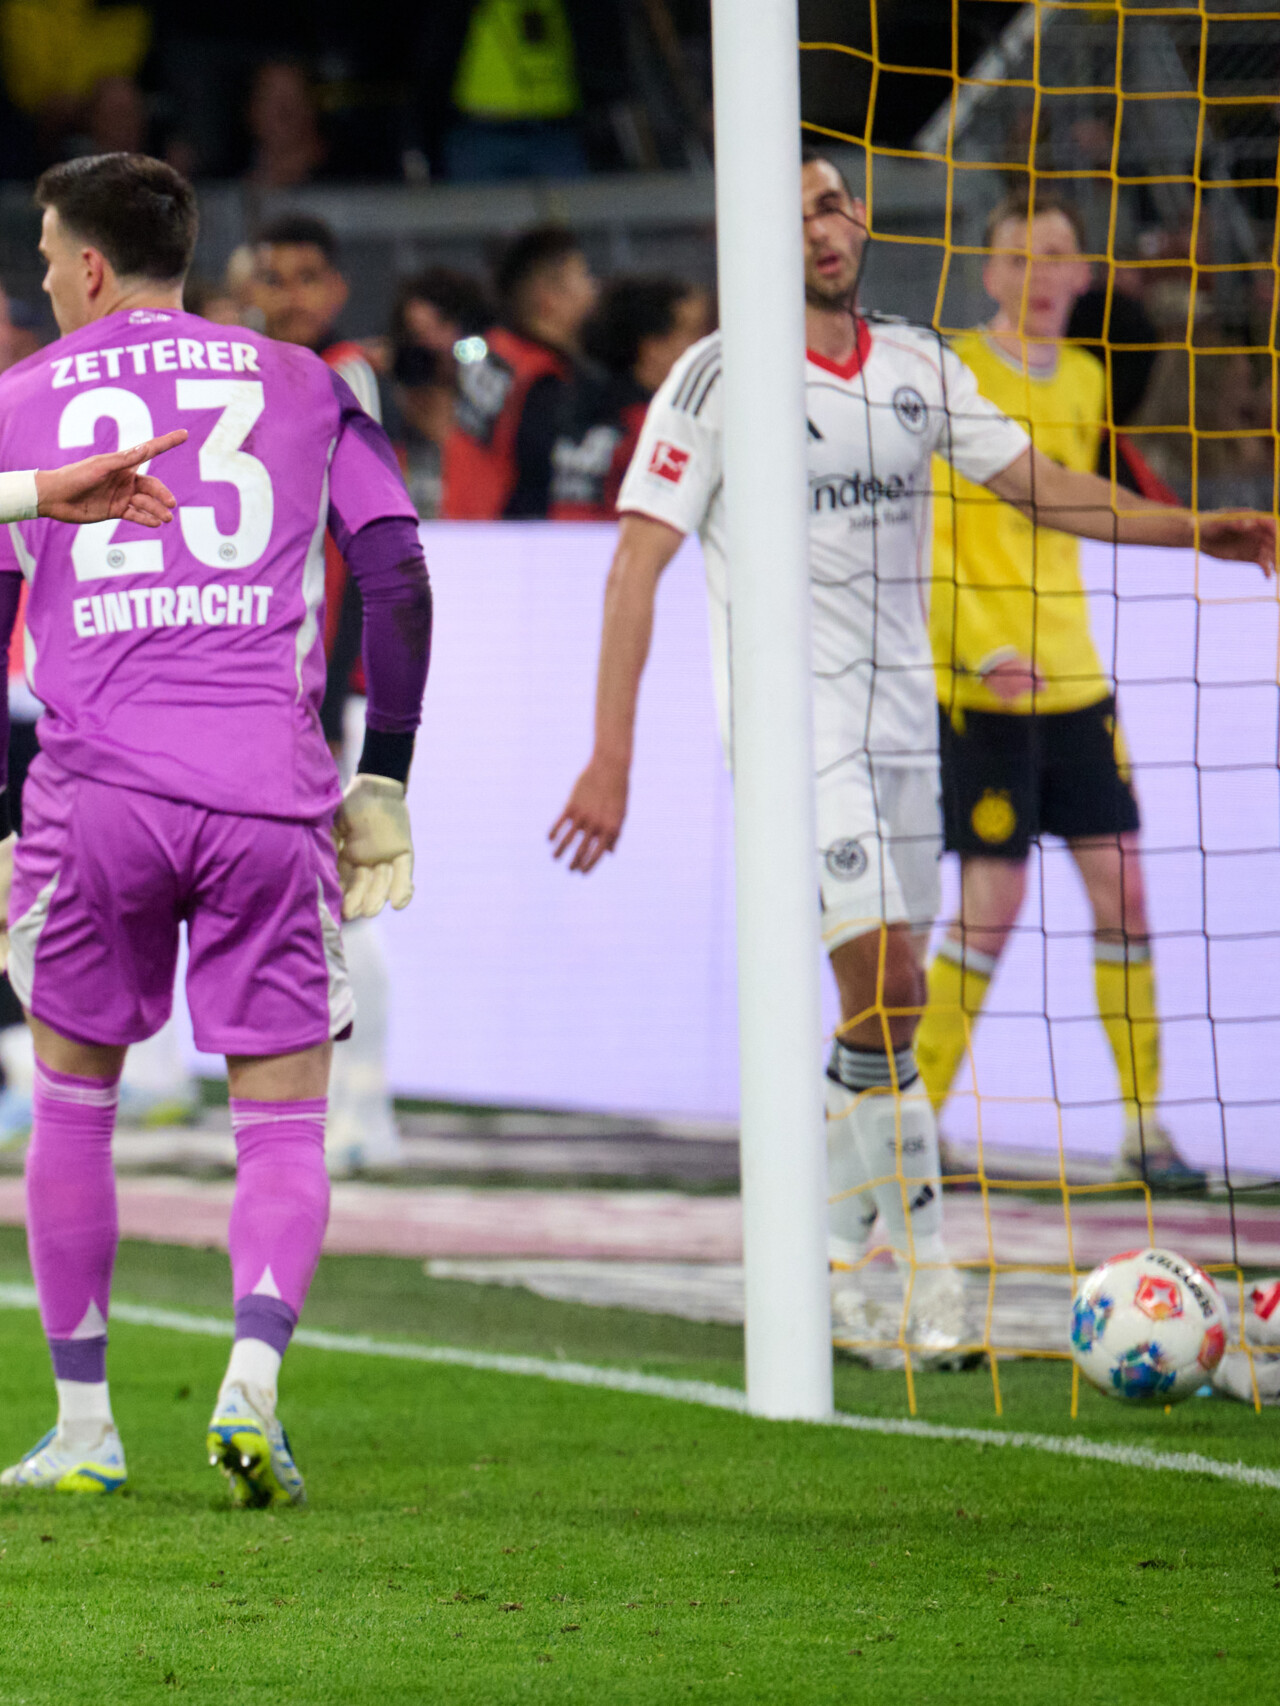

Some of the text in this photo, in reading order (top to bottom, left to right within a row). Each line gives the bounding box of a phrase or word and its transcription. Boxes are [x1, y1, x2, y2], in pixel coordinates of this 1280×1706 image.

[50, 338, 260, 389] ZETTERER
[58, 379, 274, 582] 23
[72, 583, 274, 638] EINTRACHT
